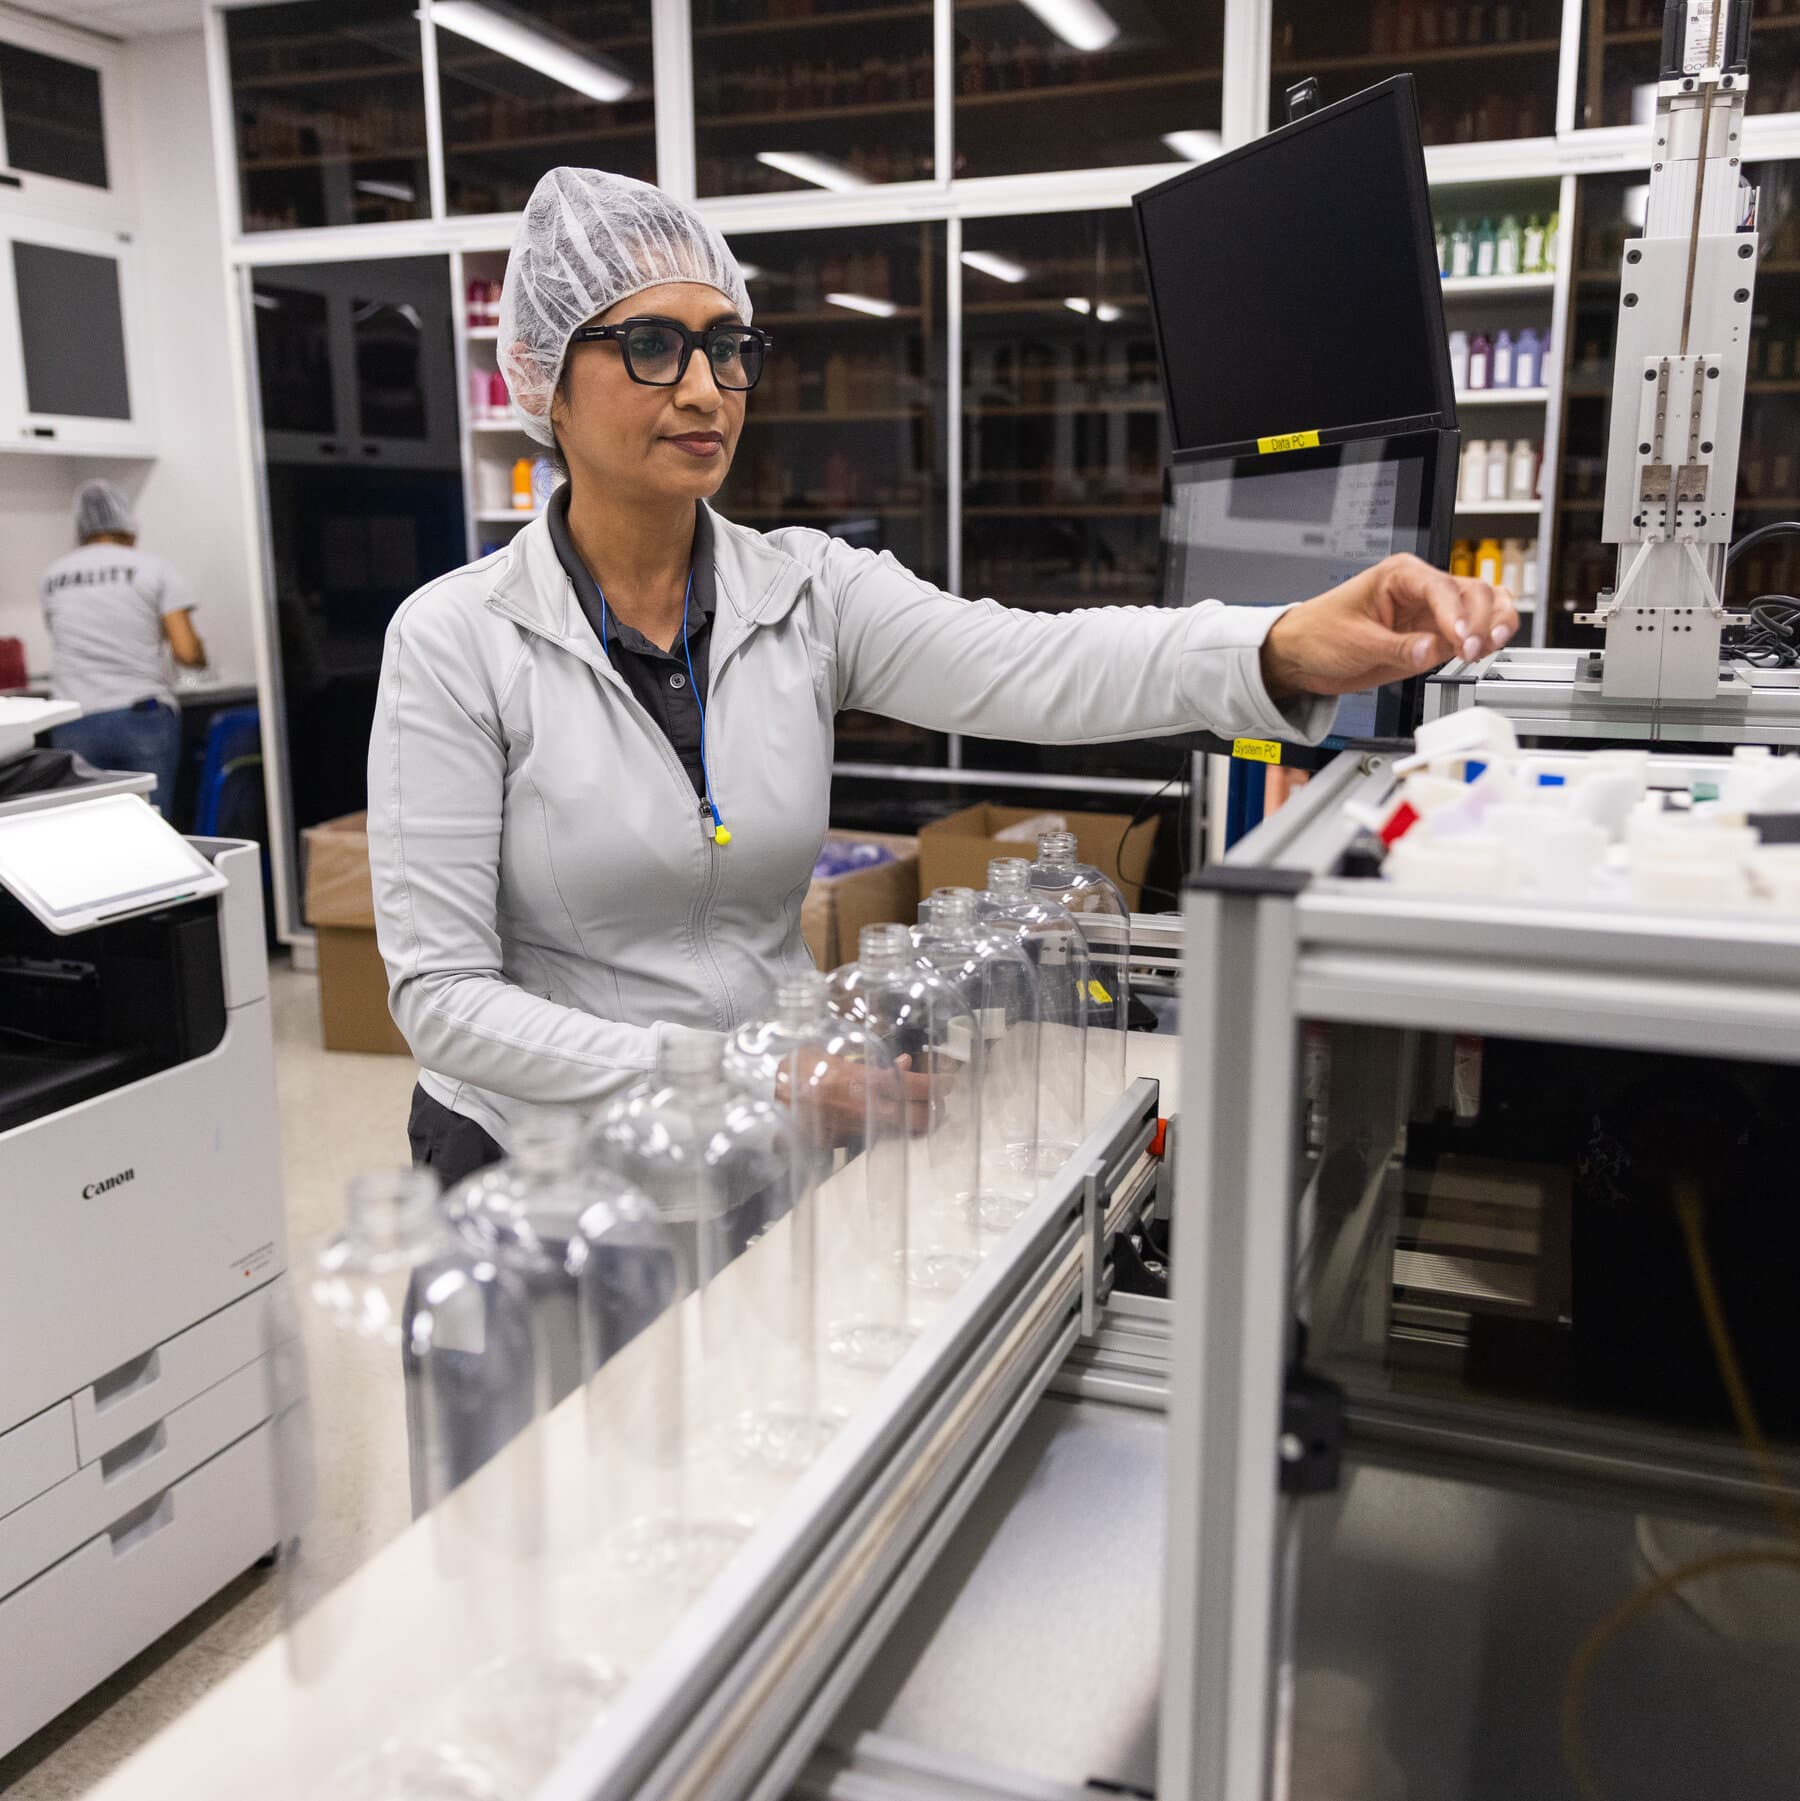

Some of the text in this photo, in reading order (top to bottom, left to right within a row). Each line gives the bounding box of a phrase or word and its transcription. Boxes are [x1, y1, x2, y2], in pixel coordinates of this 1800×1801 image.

[1271, 434, 1305, 450] Data PC
[1234, 740, 1276, 759] System PC
[82, 1167, 135, 1200] Canon
